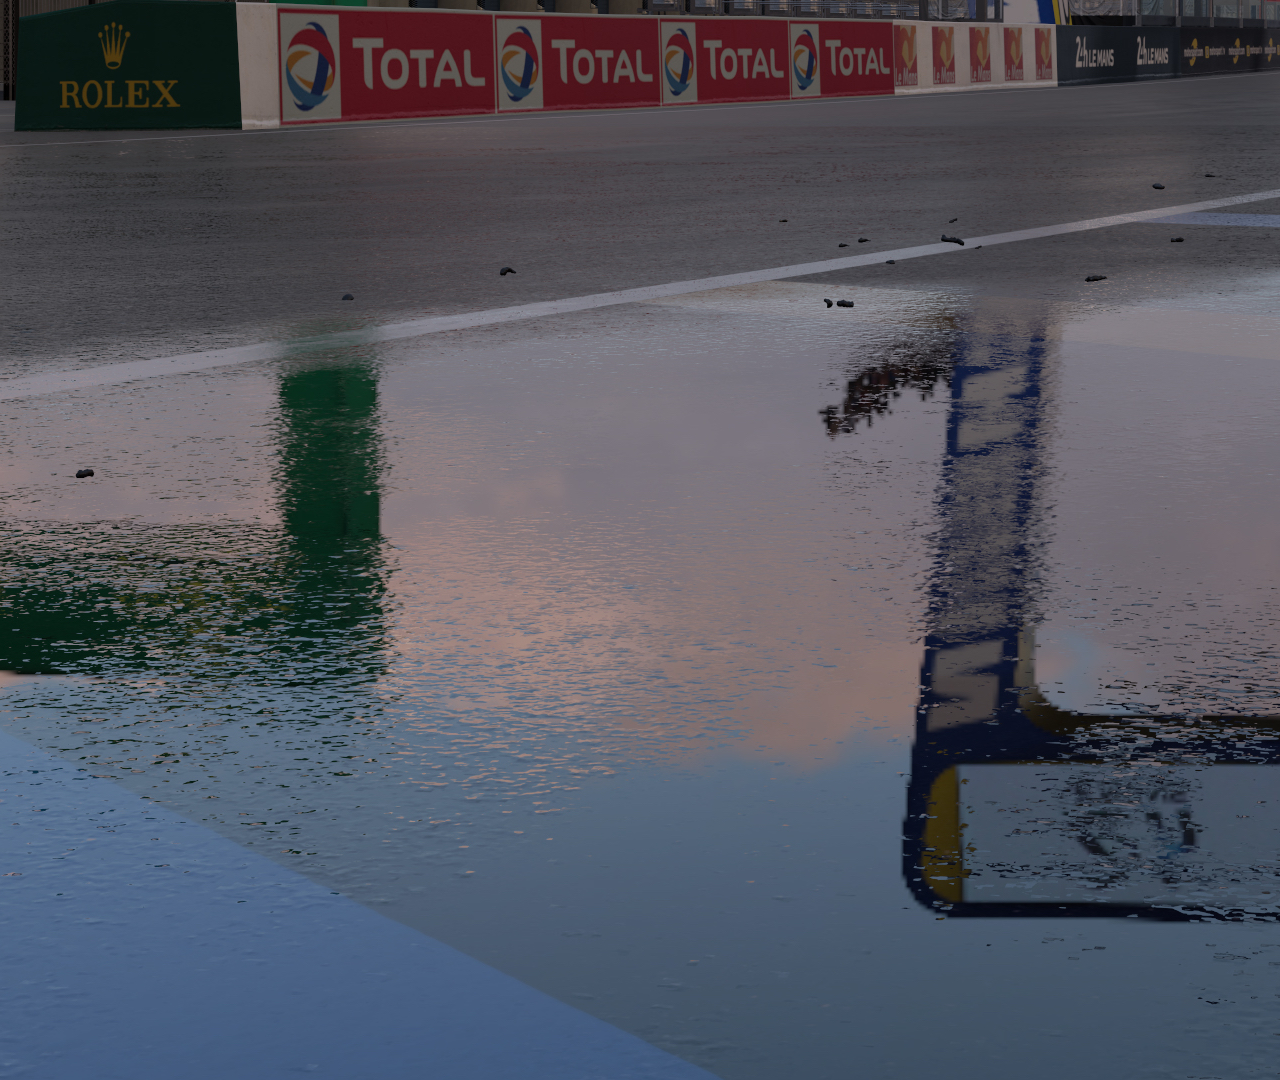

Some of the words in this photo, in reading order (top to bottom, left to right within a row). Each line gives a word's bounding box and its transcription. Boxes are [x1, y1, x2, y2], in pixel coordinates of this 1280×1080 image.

[352, 37, 486, 90] TOTAL
[551, 38, 654, 84] TOTAL
[703, 39, 785, 80] TOTAL
[825, 39, 891, 76] TOTAL
[1089, 49, 1097, 68] LE
[1098, 49, 1115, 67] MANS
[1148, 48, 1155, 65] LE
[1155, 47, 1169, 65] MANS
[59, 80, 180, 109] ROLEX
